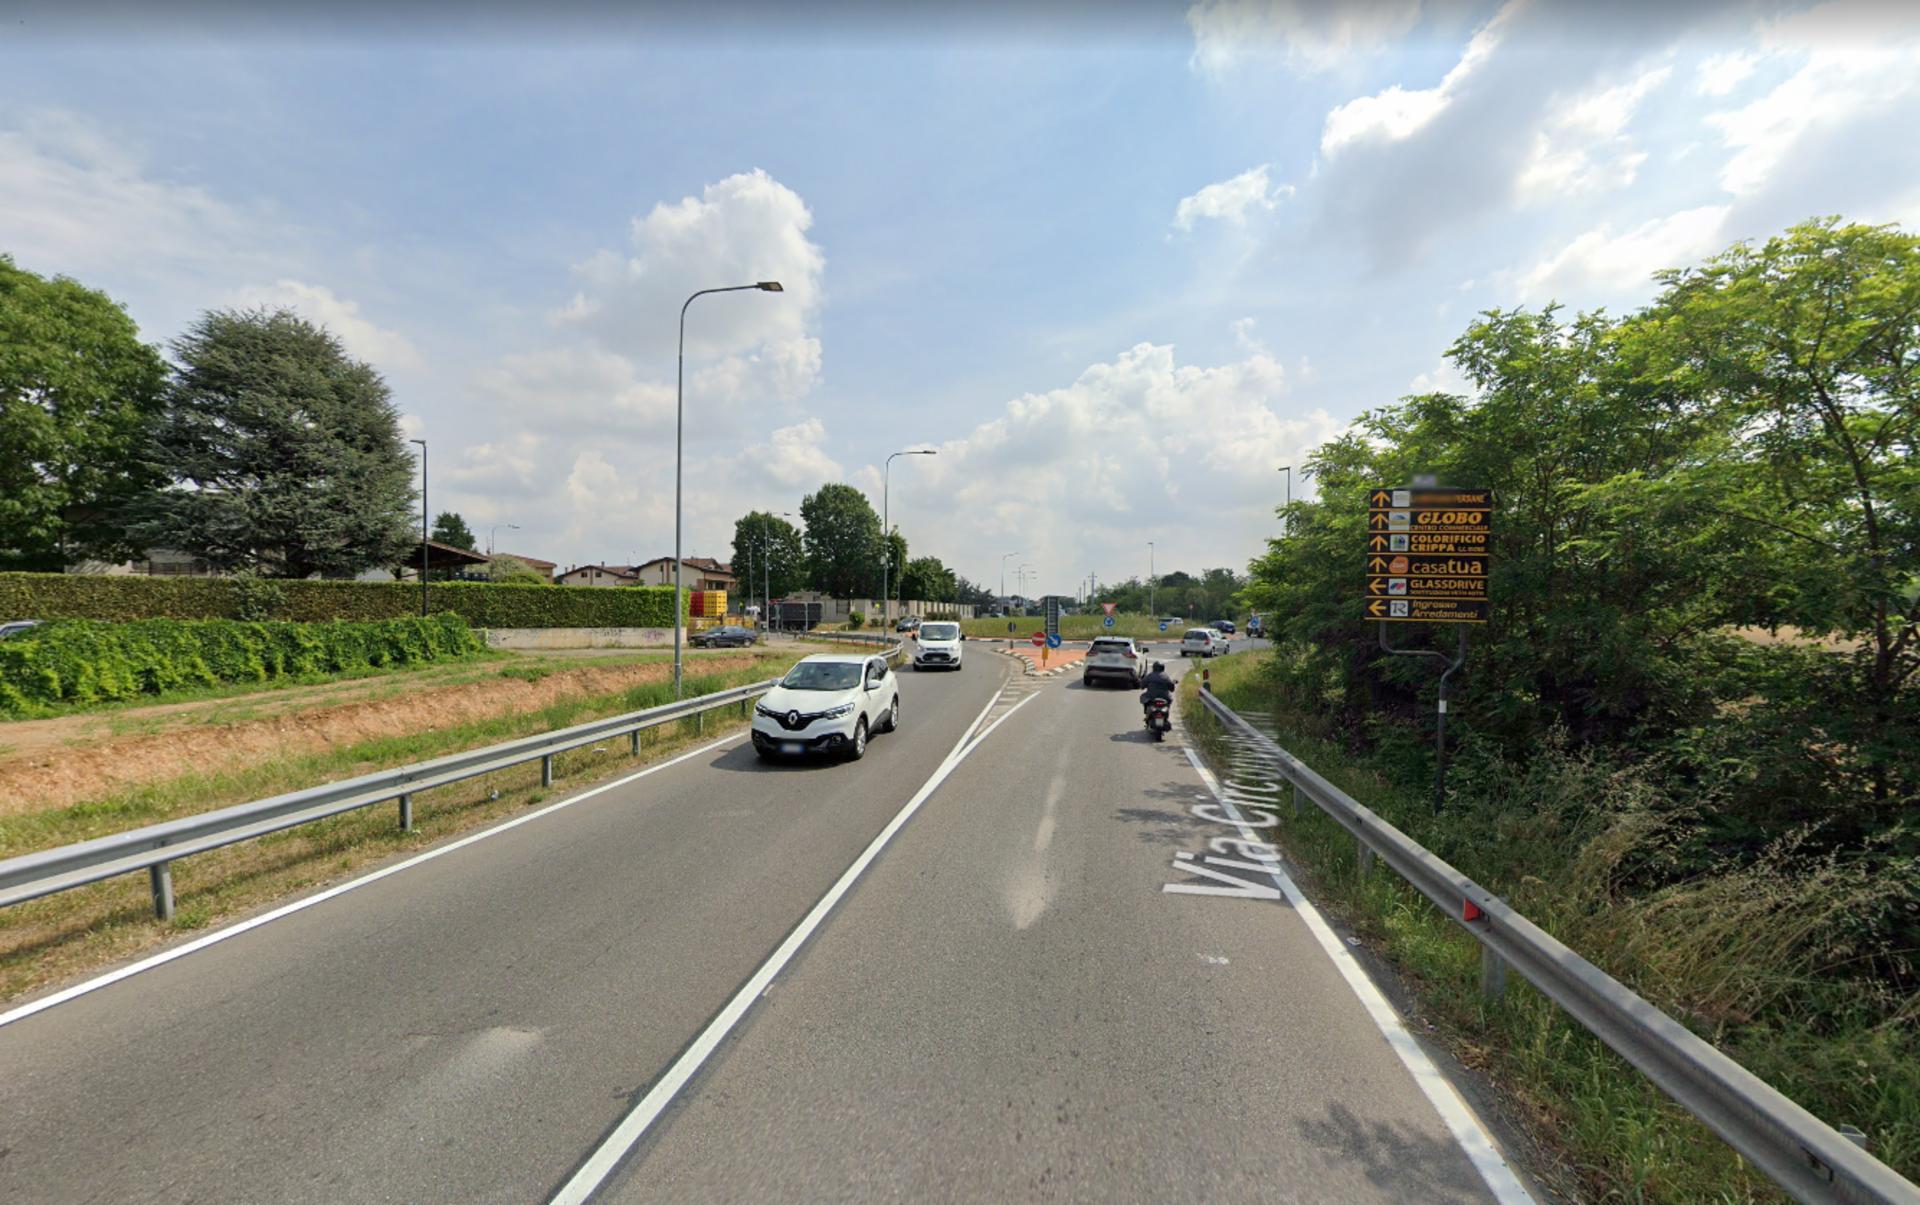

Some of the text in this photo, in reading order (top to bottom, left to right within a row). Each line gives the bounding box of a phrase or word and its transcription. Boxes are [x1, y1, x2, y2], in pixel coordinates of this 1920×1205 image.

[1417, 512, 1483, 525] GLOBO
[1411, 535, 1486, 544] COLORIFICIO
[1410, 544, 1455, 552] CRIPPA
[1411, 559, 1482, 574] casatua
[1410, 579, 1485, 589] GLASSDRIVE
[1412, 600, 1457, 610] Ingrosso
[1411, 609, 1478, 618] Arredamenti
